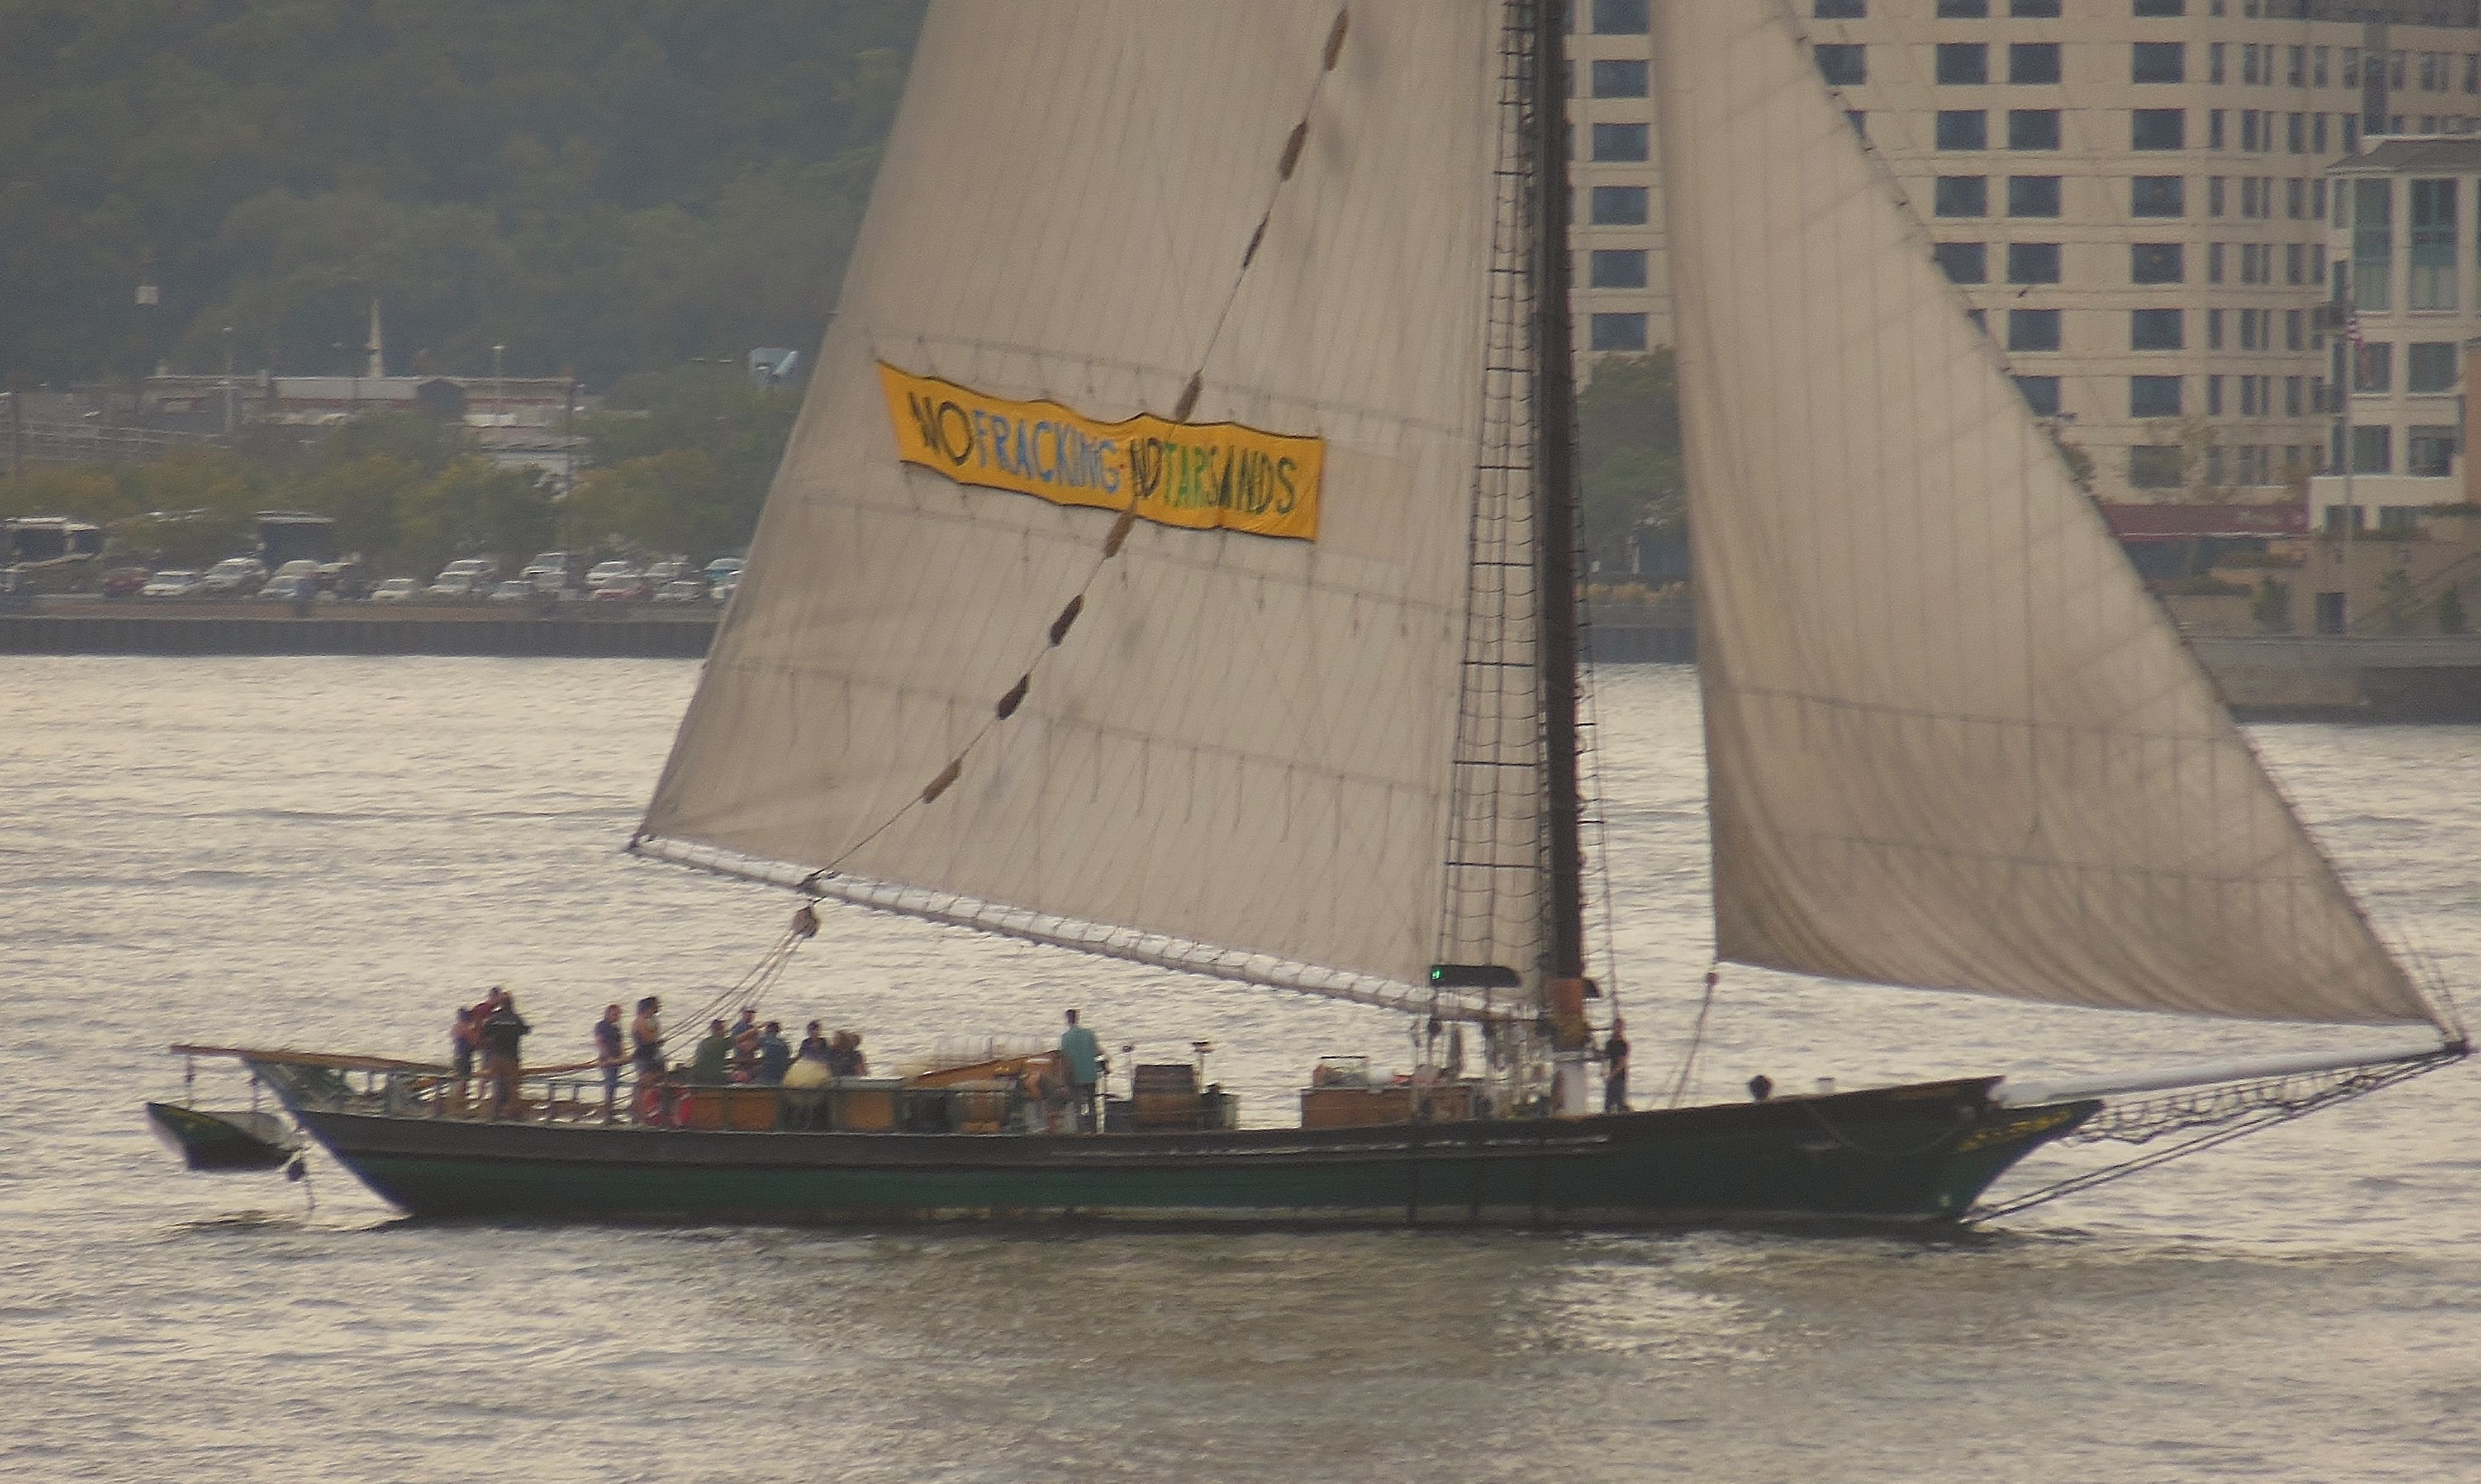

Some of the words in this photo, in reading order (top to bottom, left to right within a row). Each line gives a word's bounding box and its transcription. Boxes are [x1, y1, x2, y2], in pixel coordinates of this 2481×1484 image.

[907, 392, 974, 467] NO
[973, 408, 1120, 494] FRACKING
[1129, 437, 1163, 498] NO
[1163, 441, 1208, 507] TAR
[1206, 445, 1297, 514] SANDS
